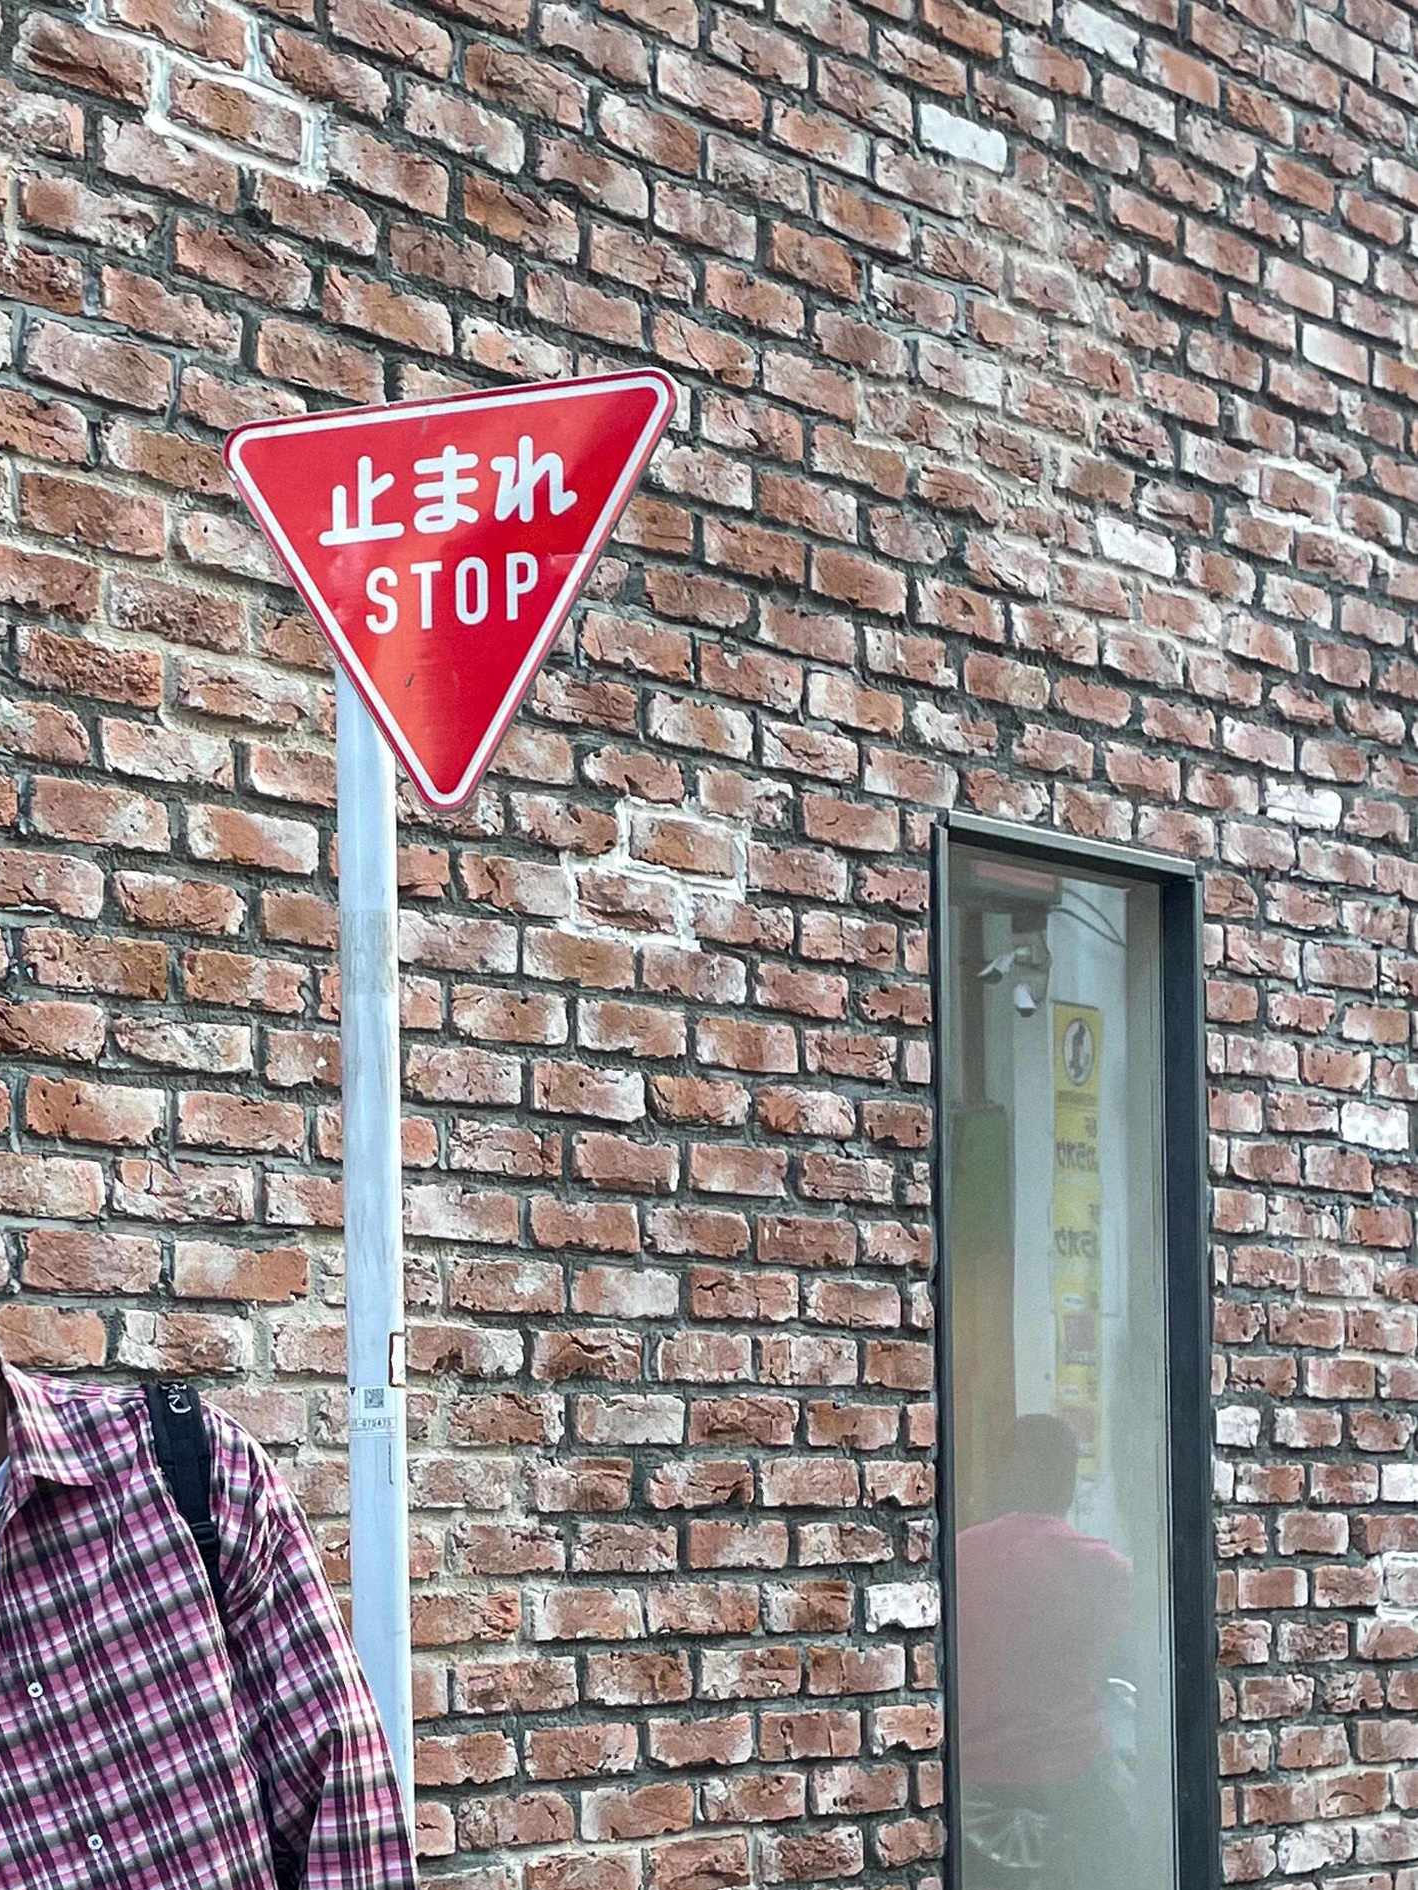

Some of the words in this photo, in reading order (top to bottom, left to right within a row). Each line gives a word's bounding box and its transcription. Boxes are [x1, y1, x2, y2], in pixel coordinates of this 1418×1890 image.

[318, 434, 578, 547] 止まれ
[365, 552, 539, 635] STOP
